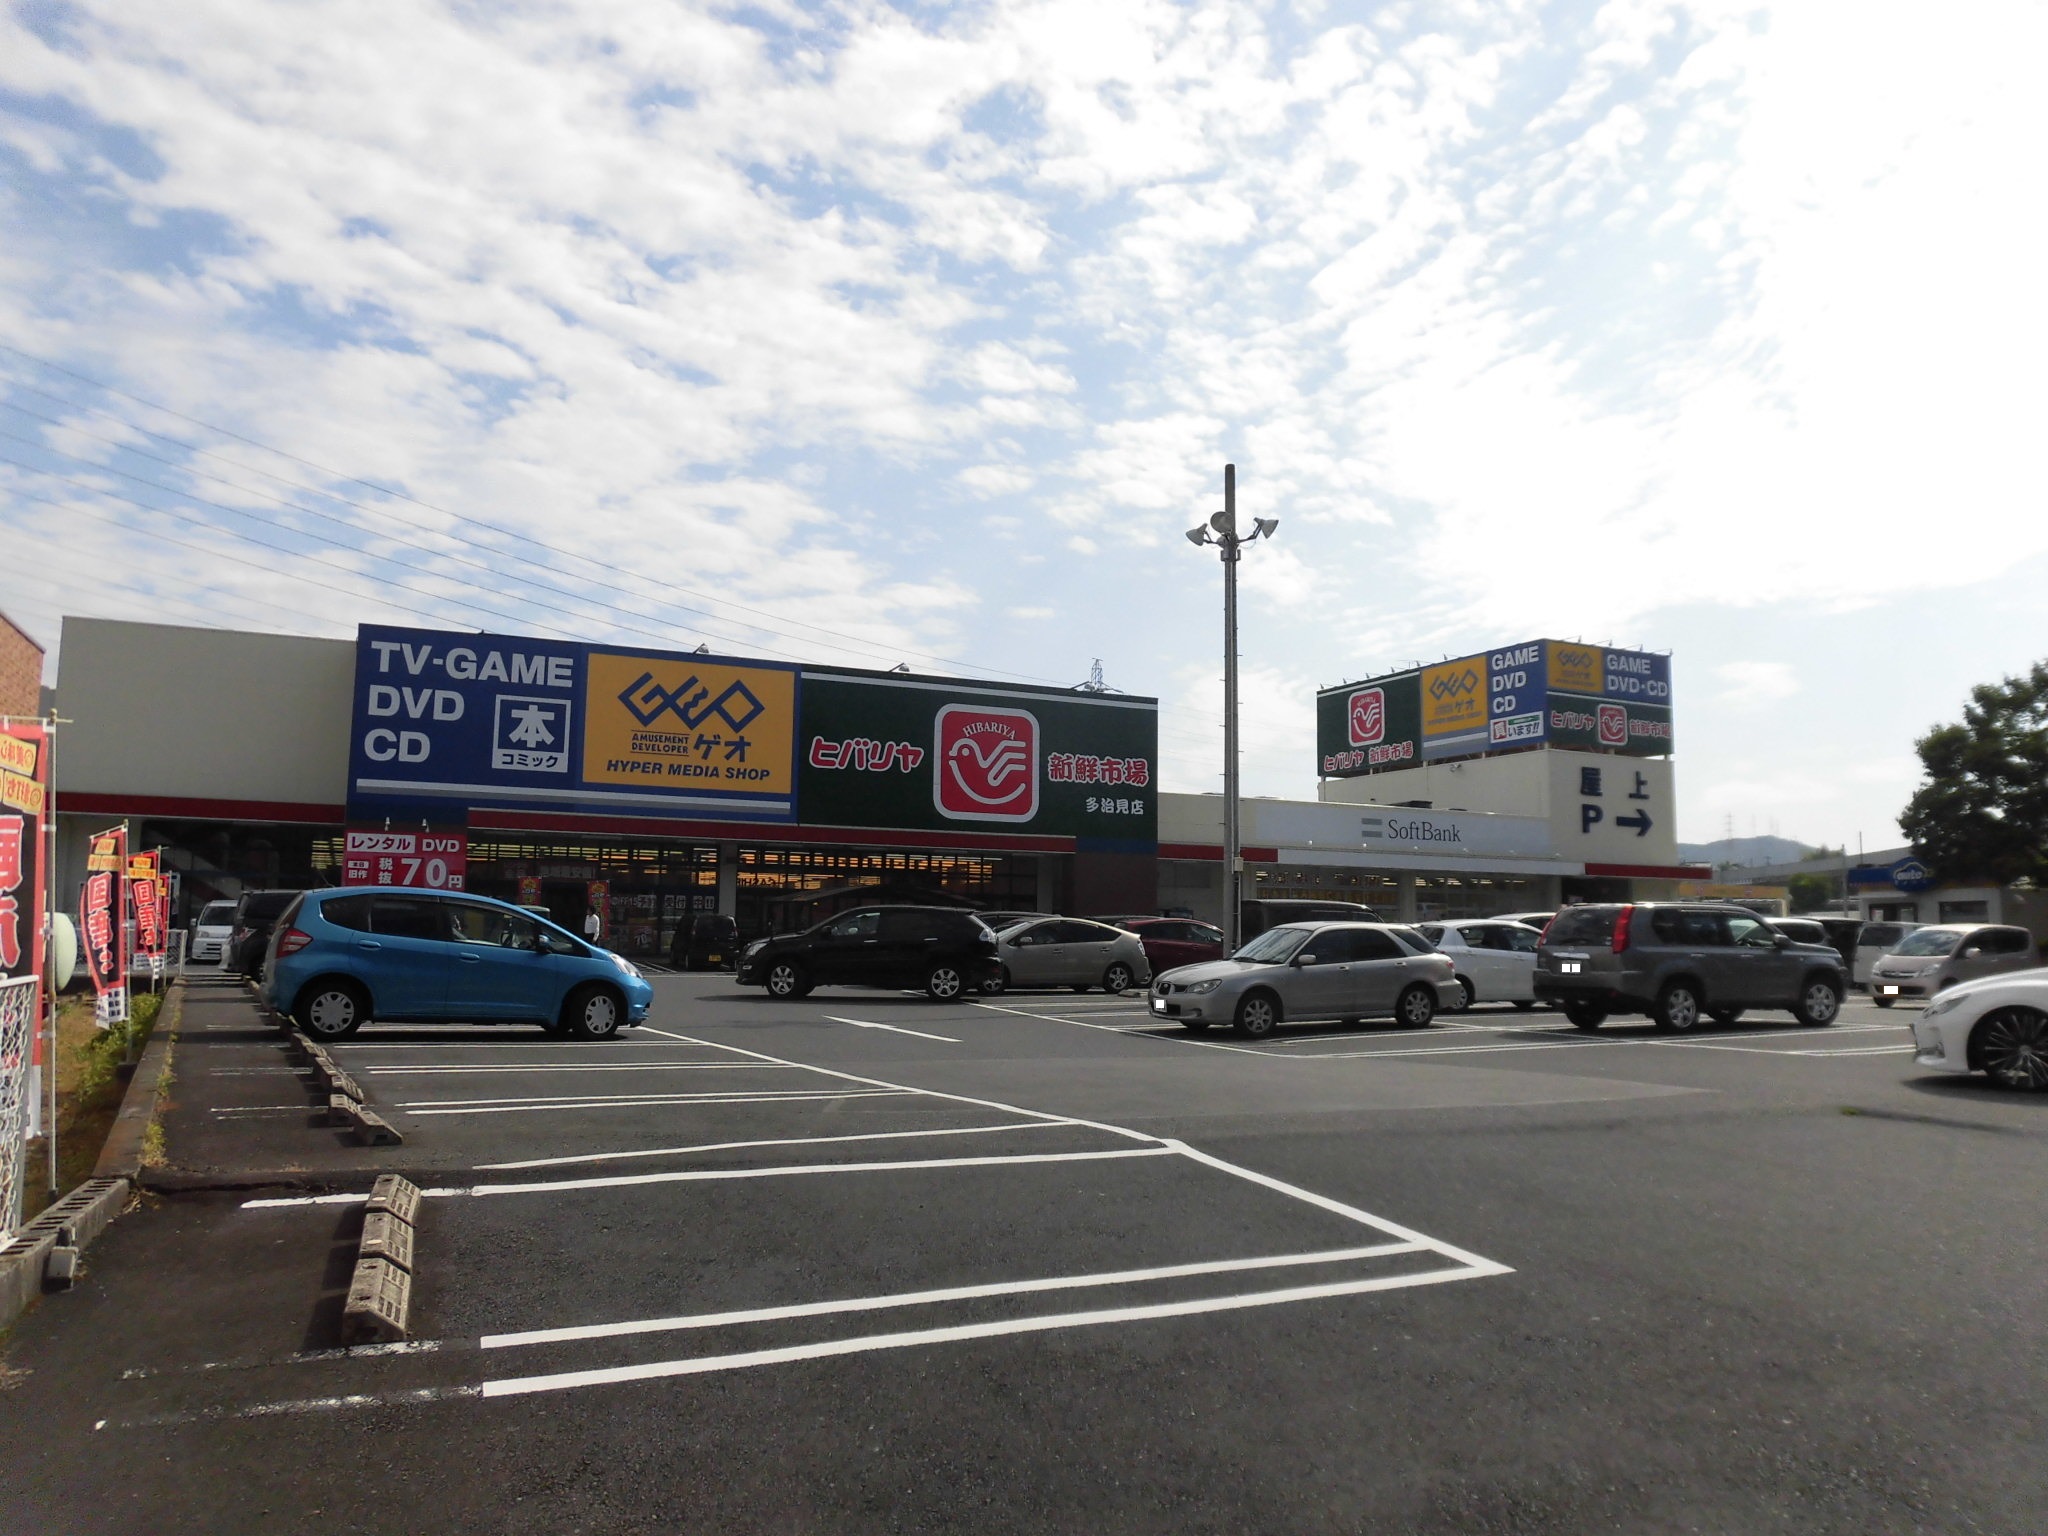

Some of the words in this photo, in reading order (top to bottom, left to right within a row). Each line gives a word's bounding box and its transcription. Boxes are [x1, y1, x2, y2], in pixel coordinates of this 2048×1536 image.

[371, 641, 574, 688] TV-GAME
[1492, 646, 1539, 671] GAME
[1607, 654, 1651, 675] GAME
[1492, 671, 1527, 692] DVD
[368, 685, 465, 721] DVD
[1492, 695, 1517, 714] CD
[509, 705, 555, 749] 本
[962, 721, 1016, 741] HIBARIYA
[1551, 710, 1596, 731] ヒバリヤ
[364, 729, 430, 763] CD
[632, 733, 689, 744] AMUSEMENT
[632, 743, 689, 754] DEVELOPER
[694, 733, 751, 763] ゲオ
[501, 752, 559, 769] コミック
[809, 736, 925, 773] ヒバリヤ
[1324, 749, 1364, 772] ヒバリヤ
[1368, 740, 1414, 764] 新鮮市場
[606, 759, 662, 774] HYPER
[667, 763, 720, 778] MEDIA
[725, 767, 771, 781] SHOP
[1048, 752, 1150, 787] 新鮮市場
[1085, 797, 1144, 815] 多治見店
[1582, 804, 1603, 833] P
[1388, 819, 1461, 843] SoftBank
[351, 836, 411, 851] レンタル
[422, 839, 460, 852] DVD
